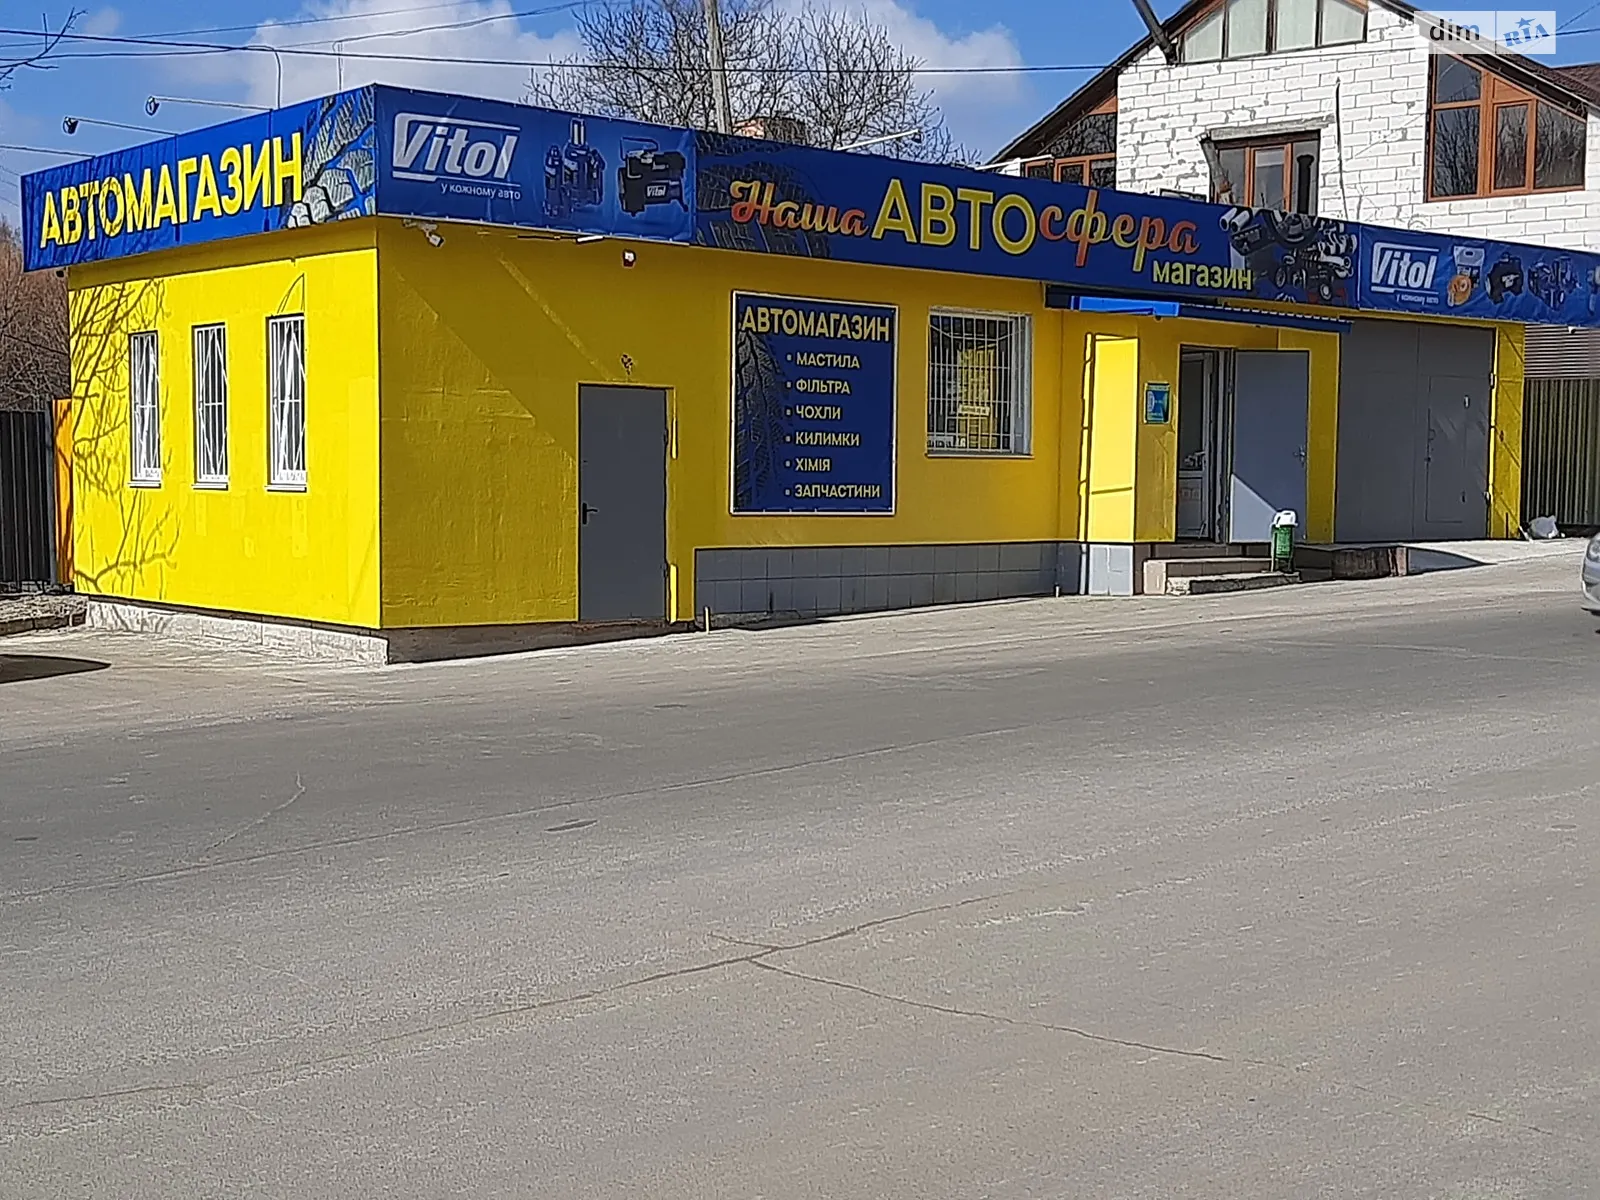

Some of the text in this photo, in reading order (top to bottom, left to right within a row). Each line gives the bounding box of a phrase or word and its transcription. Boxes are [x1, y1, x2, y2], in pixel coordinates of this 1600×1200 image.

[392, 113, 520, 180] Vitol
[40, 132, 304, 248] АВТОМАГАЗИН
[441, 183, 521, 200] у кожному авто
[729, 179, 870, 236] Наша
[1371, 242, 1439, 292] Vitol
[1152, 260, 1253, 292] магазин
[741, 305, 890, 342] АВТОМАГАЗИН
[796, 352, 860, 369] МАСТИЛА
[795, 378, 851, 394] ФІЛЬТРА
[795, 405, 841, 420] ЧОХЛИ
[795, 432, 860, 446] КИЛИМКИ
[794, 458, 831, 472] ХІМІЯ
[794, 484, 881, 498] ЗАПЧАСТИНИ
